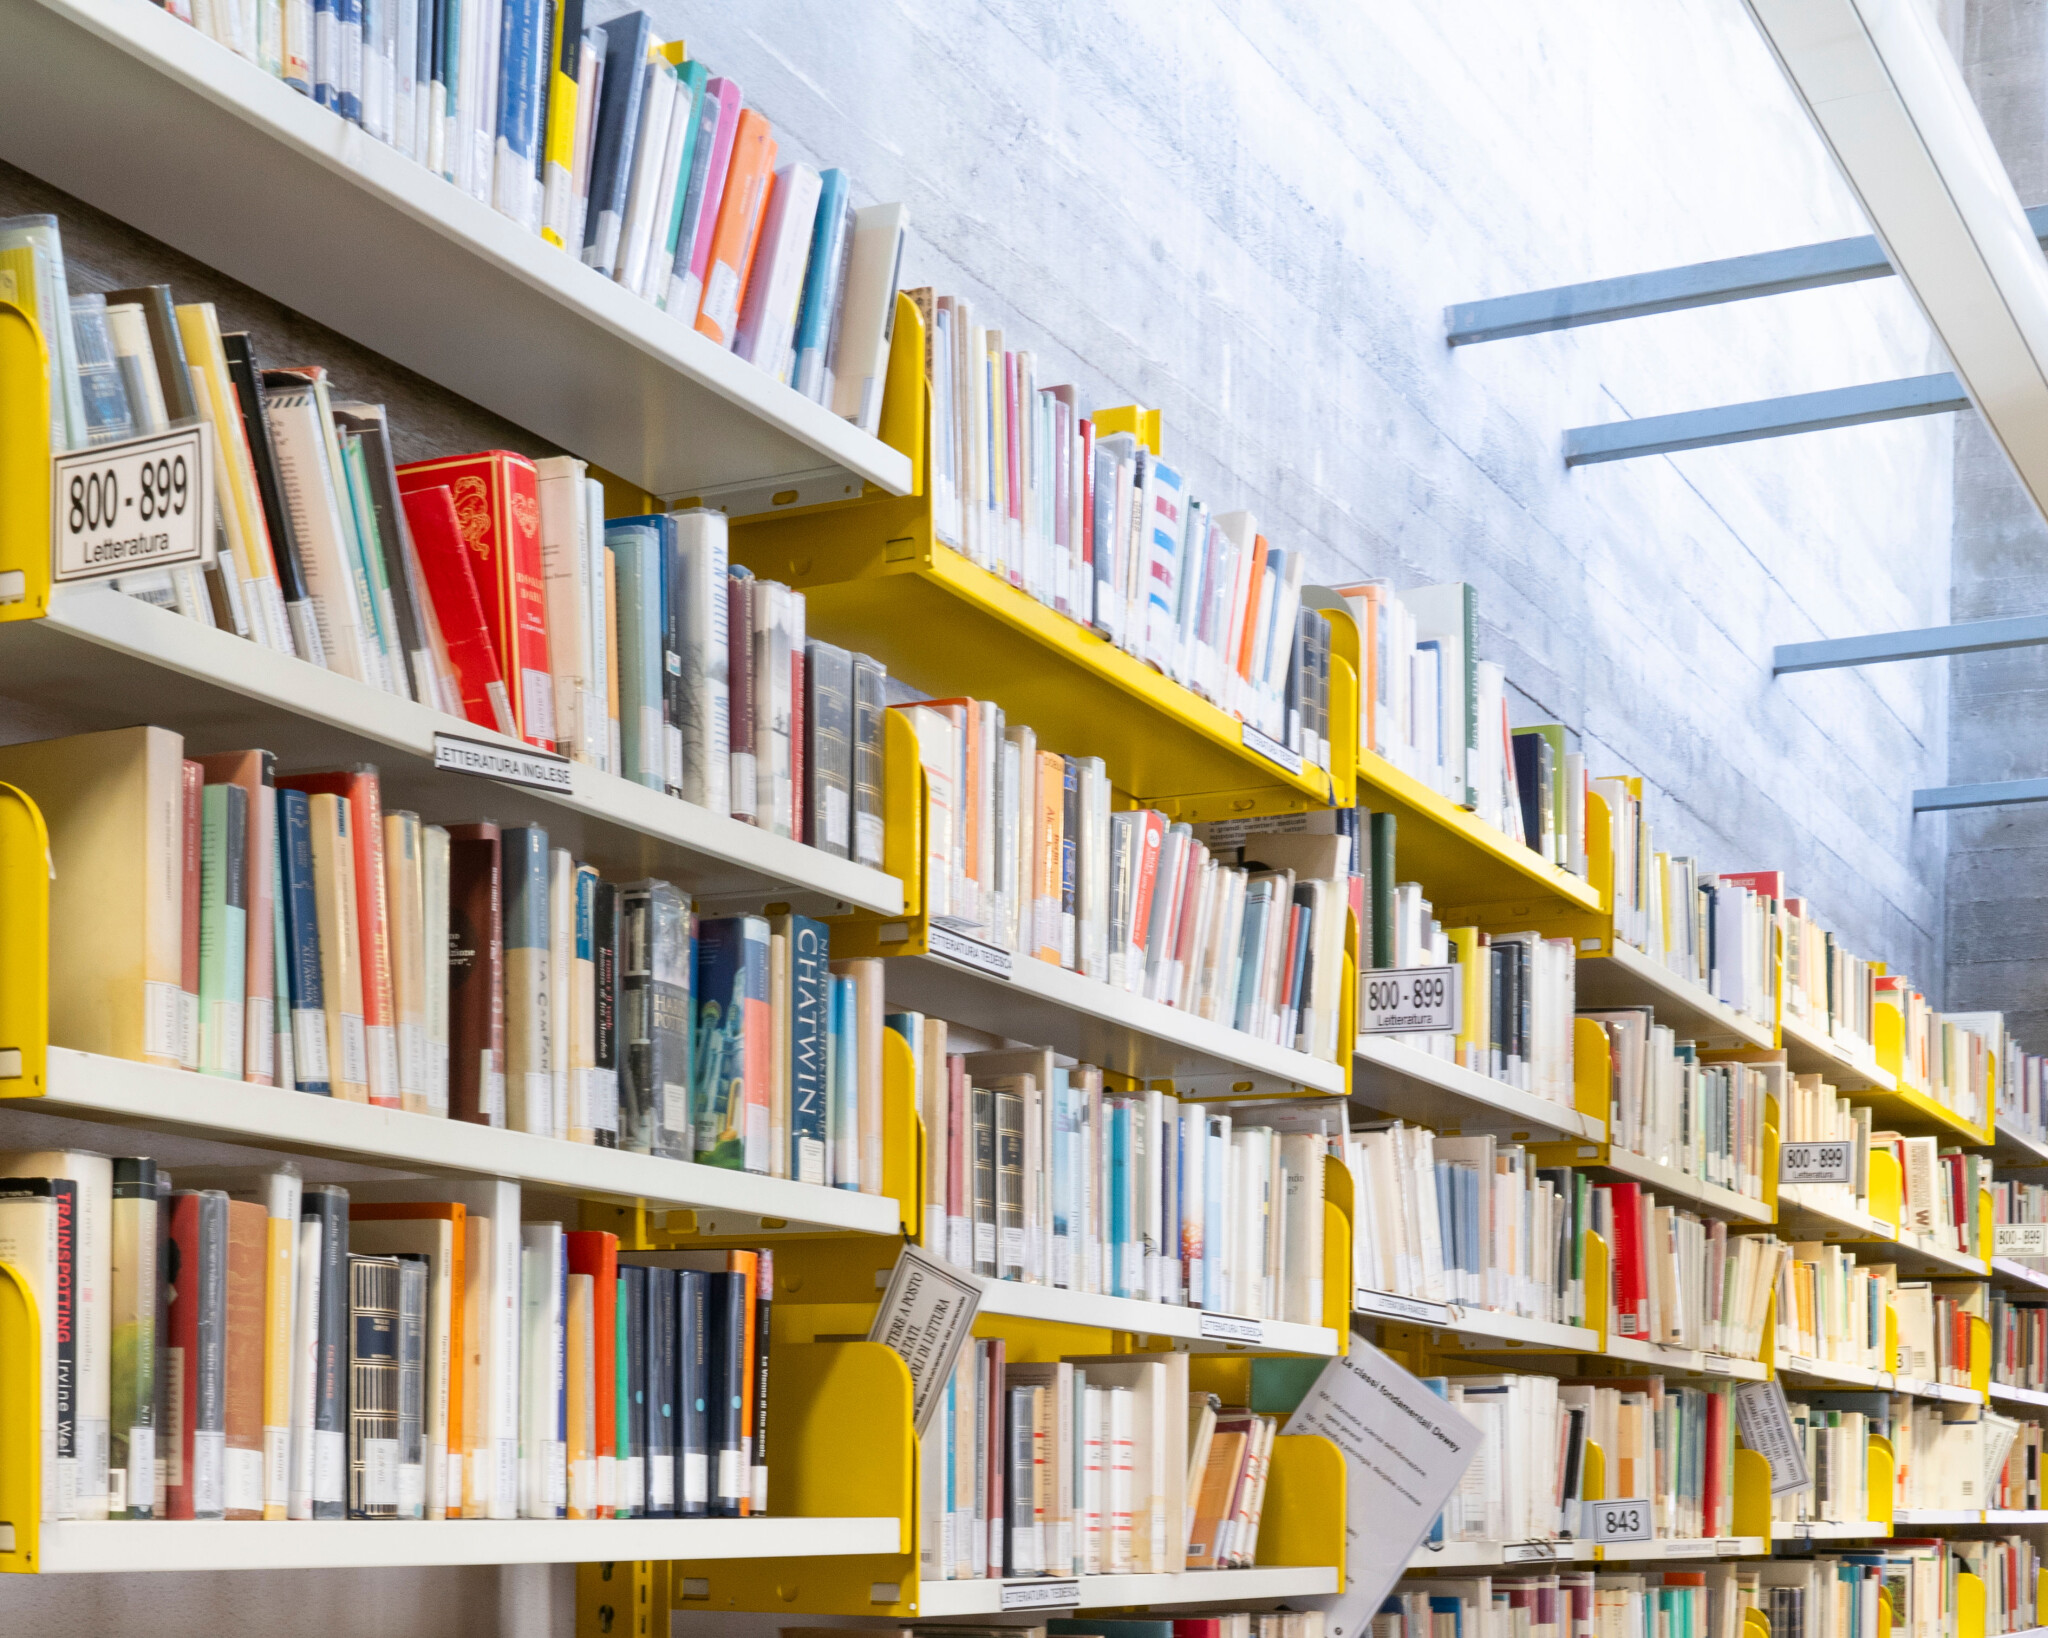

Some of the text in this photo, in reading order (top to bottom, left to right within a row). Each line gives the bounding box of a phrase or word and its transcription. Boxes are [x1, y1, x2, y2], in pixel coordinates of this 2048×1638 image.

[70, 469, 117, 534] 800
[140, 455, 187, 521] 899
[84, 532, 169, 564] Letteratura
[436, 744, 571, 785] LETTERATURA INGLESE
[1368, 980, 1400, 1011] 800
[1413, 978, 1444, 1009] 899
[797, 929, 818, 1114] CHATWIN
[818, 937, 829, 1023] NICHOLAS
[1377, 1014, 1433, 1027] Letteratura
[1786, 1149, 1810, 1169] 800
[1819, 1148, 1843, 1169] 899
[56, 1192, 73, 1343] TRAINSPOTTING
[885, 1271, 924, 1350] TTERE A POSTO
[925, 1297, 950, 1347] LETTURA
[899, 1324, 923, 1364] ULTATI.
[57, 1359, 72, 1412] Irvine
[760, 1400, 768, 1408] di
[1341, 1356, 1461, 1454] Le classi fondamentali Dewey
[1606, 1510, 1640, 1534] 843
